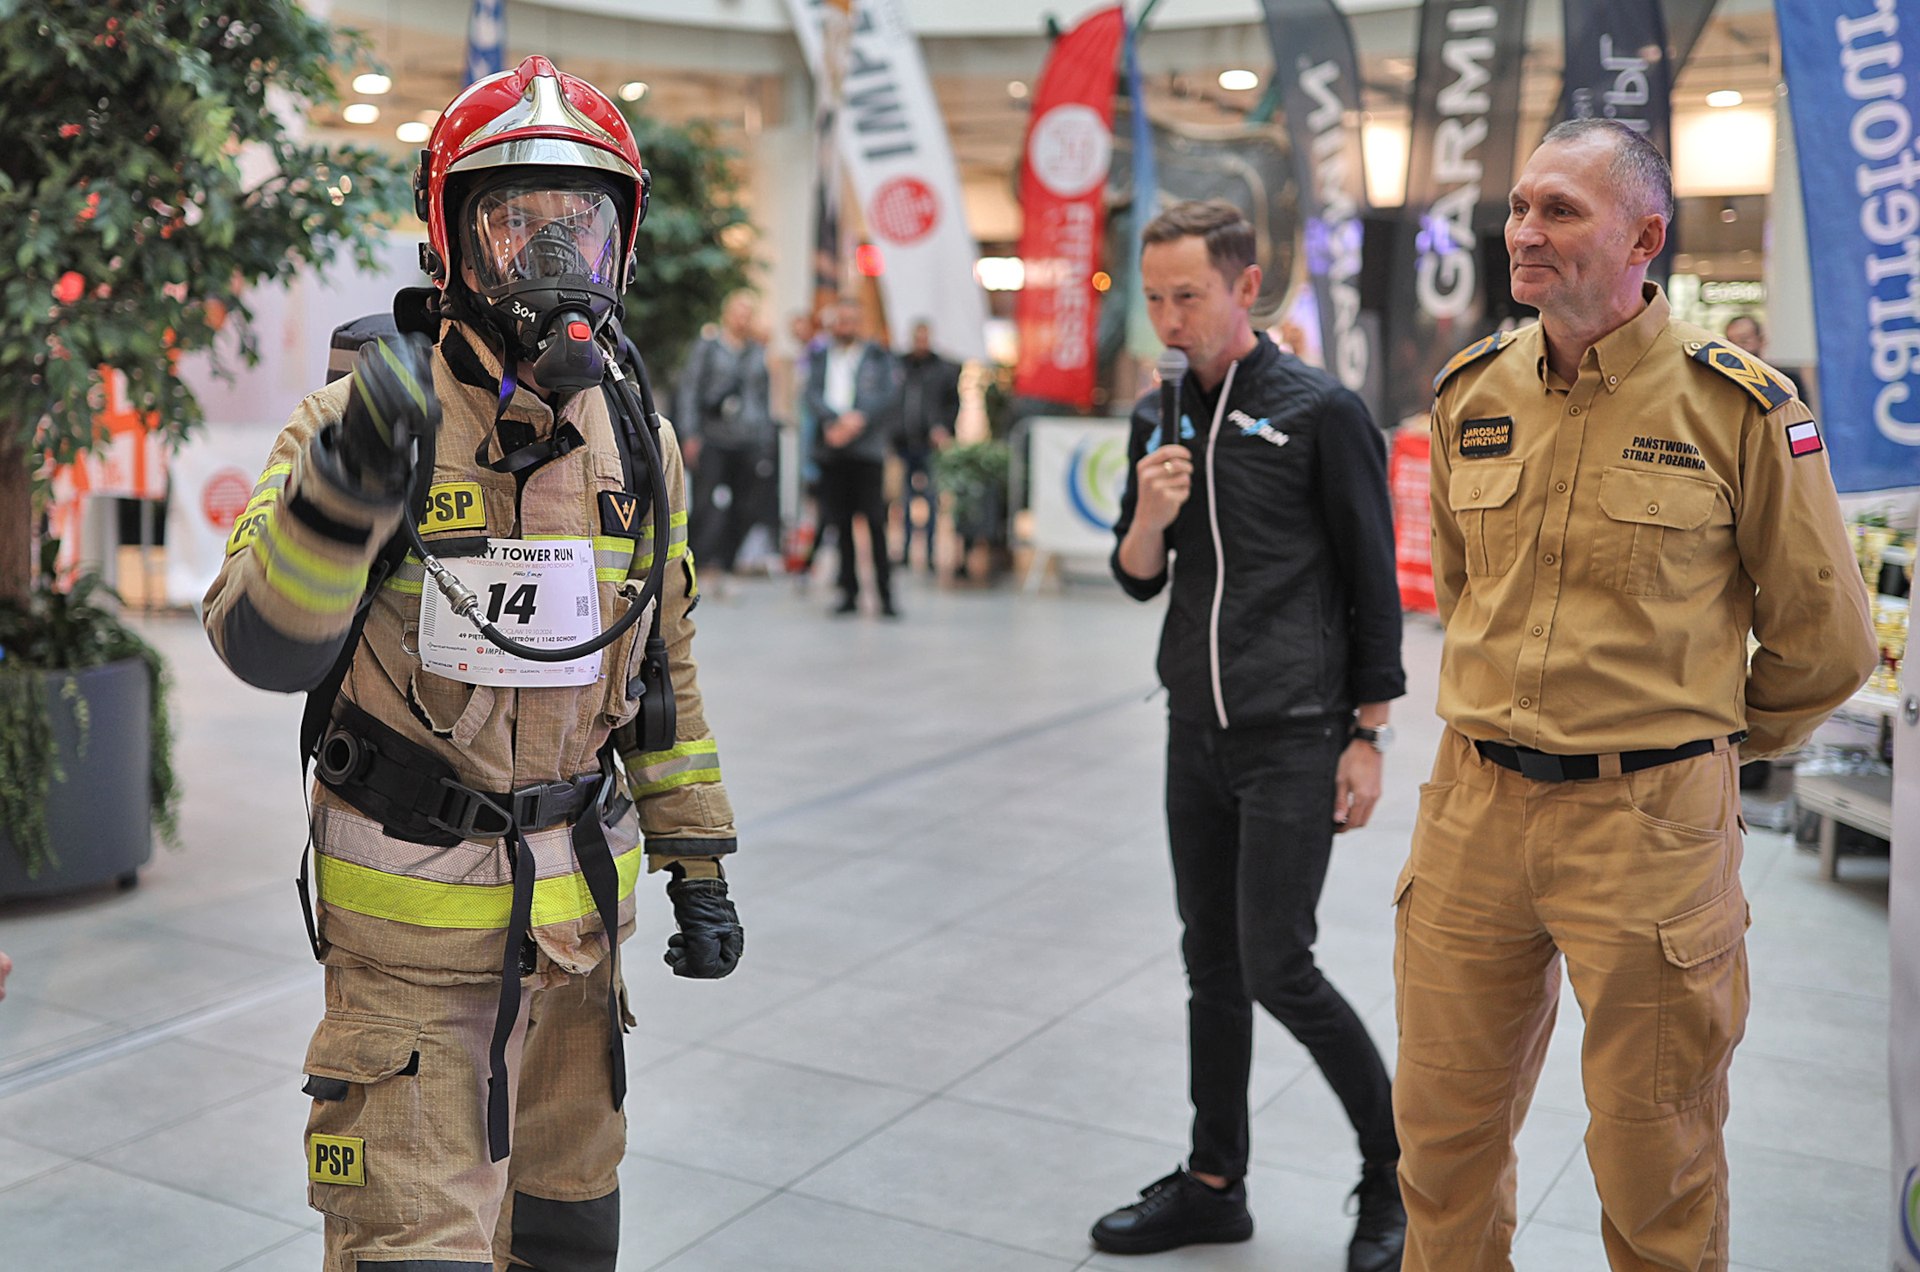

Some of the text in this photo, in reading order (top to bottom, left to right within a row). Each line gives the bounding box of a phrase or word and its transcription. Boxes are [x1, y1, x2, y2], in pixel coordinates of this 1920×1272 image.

[1416, 5, 1498, 320] GARMI
[511, 301, 537, 323] 301
[1622, 448, 1706, 471] STRAŻ POŻARNA
[1632, 436, 1699, 456] PAŃSTWOWA
[420, 491, 473, 525] PSP
[233, 514, 268, 544] PS
[502, 547, 551, 562] TOWER
[554, 548, 574, 561] RUN
[486, 583, 538, 625] 14
[315, 1143, 355, 1176] PSP
